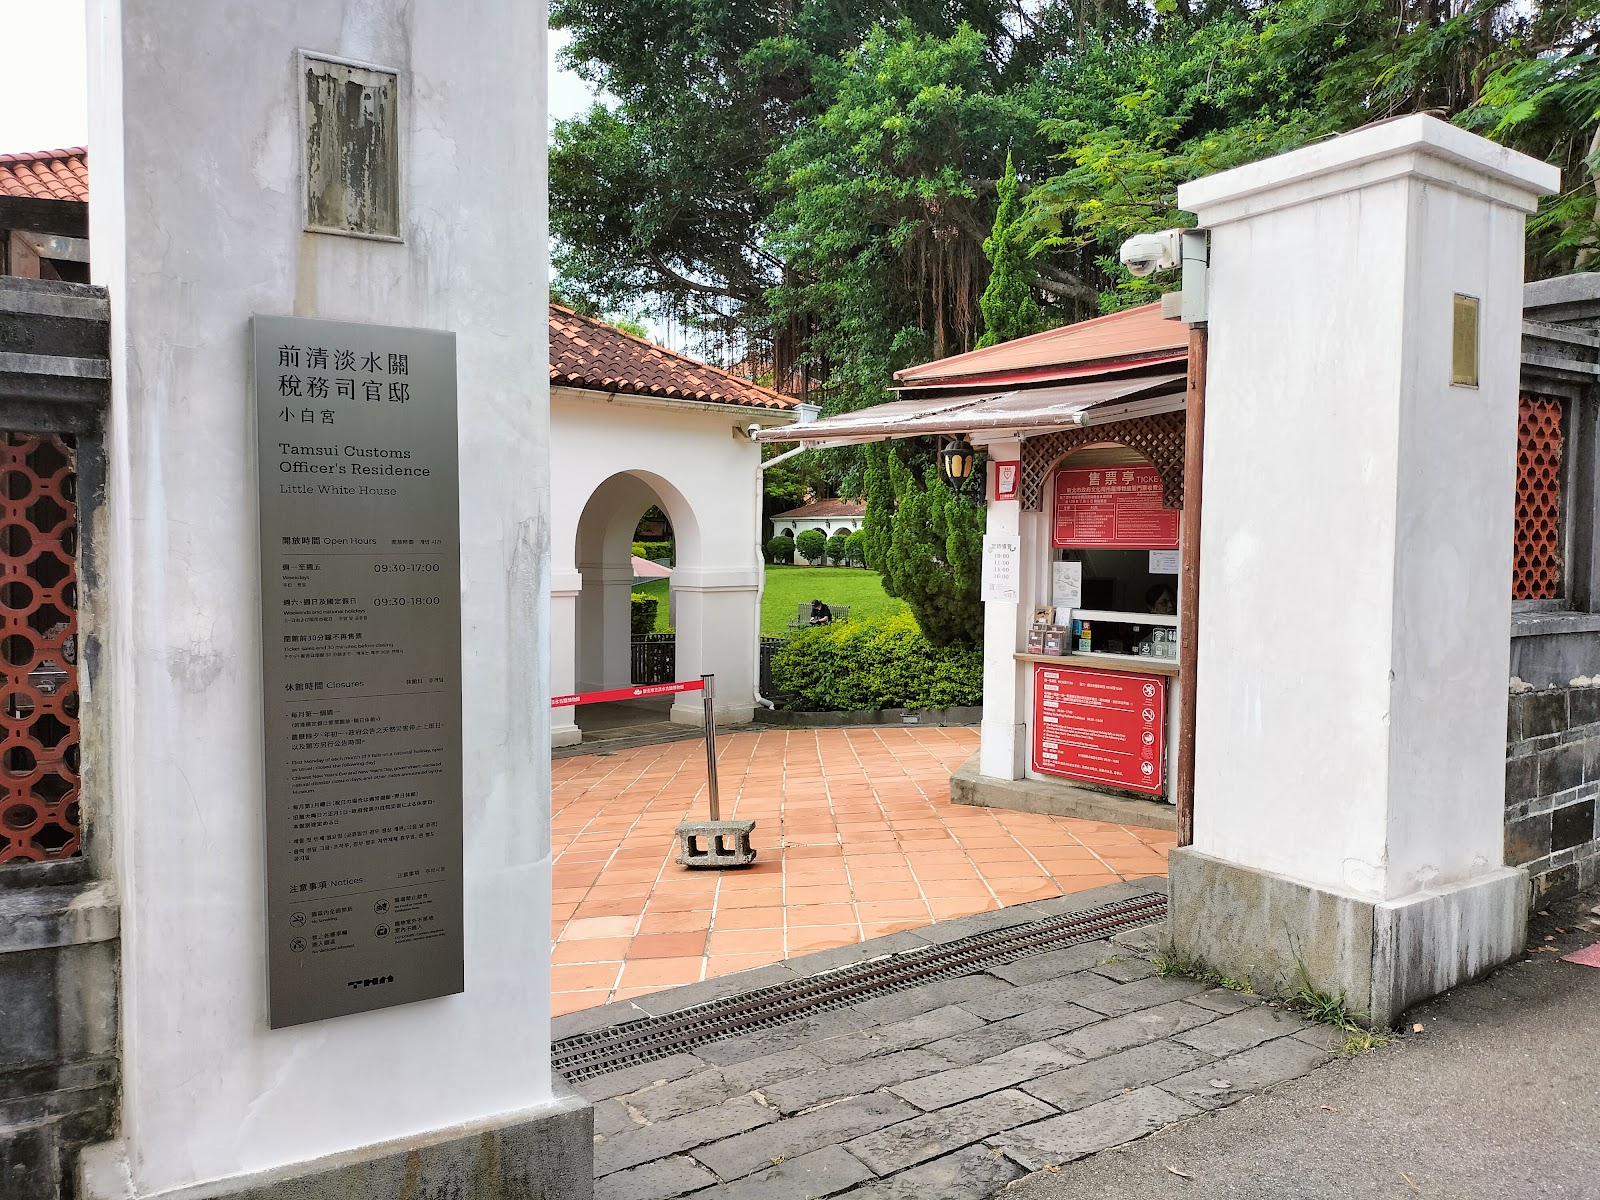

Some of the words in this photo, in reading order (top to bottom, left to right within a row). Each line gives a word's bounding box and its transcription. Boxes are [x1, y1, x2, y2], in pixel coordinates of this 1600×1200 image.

[278, 344, 409, 376] 前清淡水關
[278, 374, 410, 404] 稅務司官邸
[279, 406, 335, 425] 小白宮
[278, 442, 339, 456] Tamsui
[344, 445, 411, 459] Customs
[279, 461, 347, 474] Officer's
[350, 463, 430, 477] Residence
[1089, 471, 1135, 486] 售票亭
[280, 484, 314, 494] Little
[317, 484, 356, 495] White
[358, 485, 397, 496] House
[281, 536, 321, 546] 開放時間
[323, 537, 348, 546] Open
[350, 537, 377, 545] Hours
[374, 563, 440, 573] 09:30-17:00
[374, 597, 440, 607] 09:30-18:00
[326, 681, 365, 690] Closures
[289, 880, 328, 894] 注意事項
[330, 877, 363, 887] Notices
